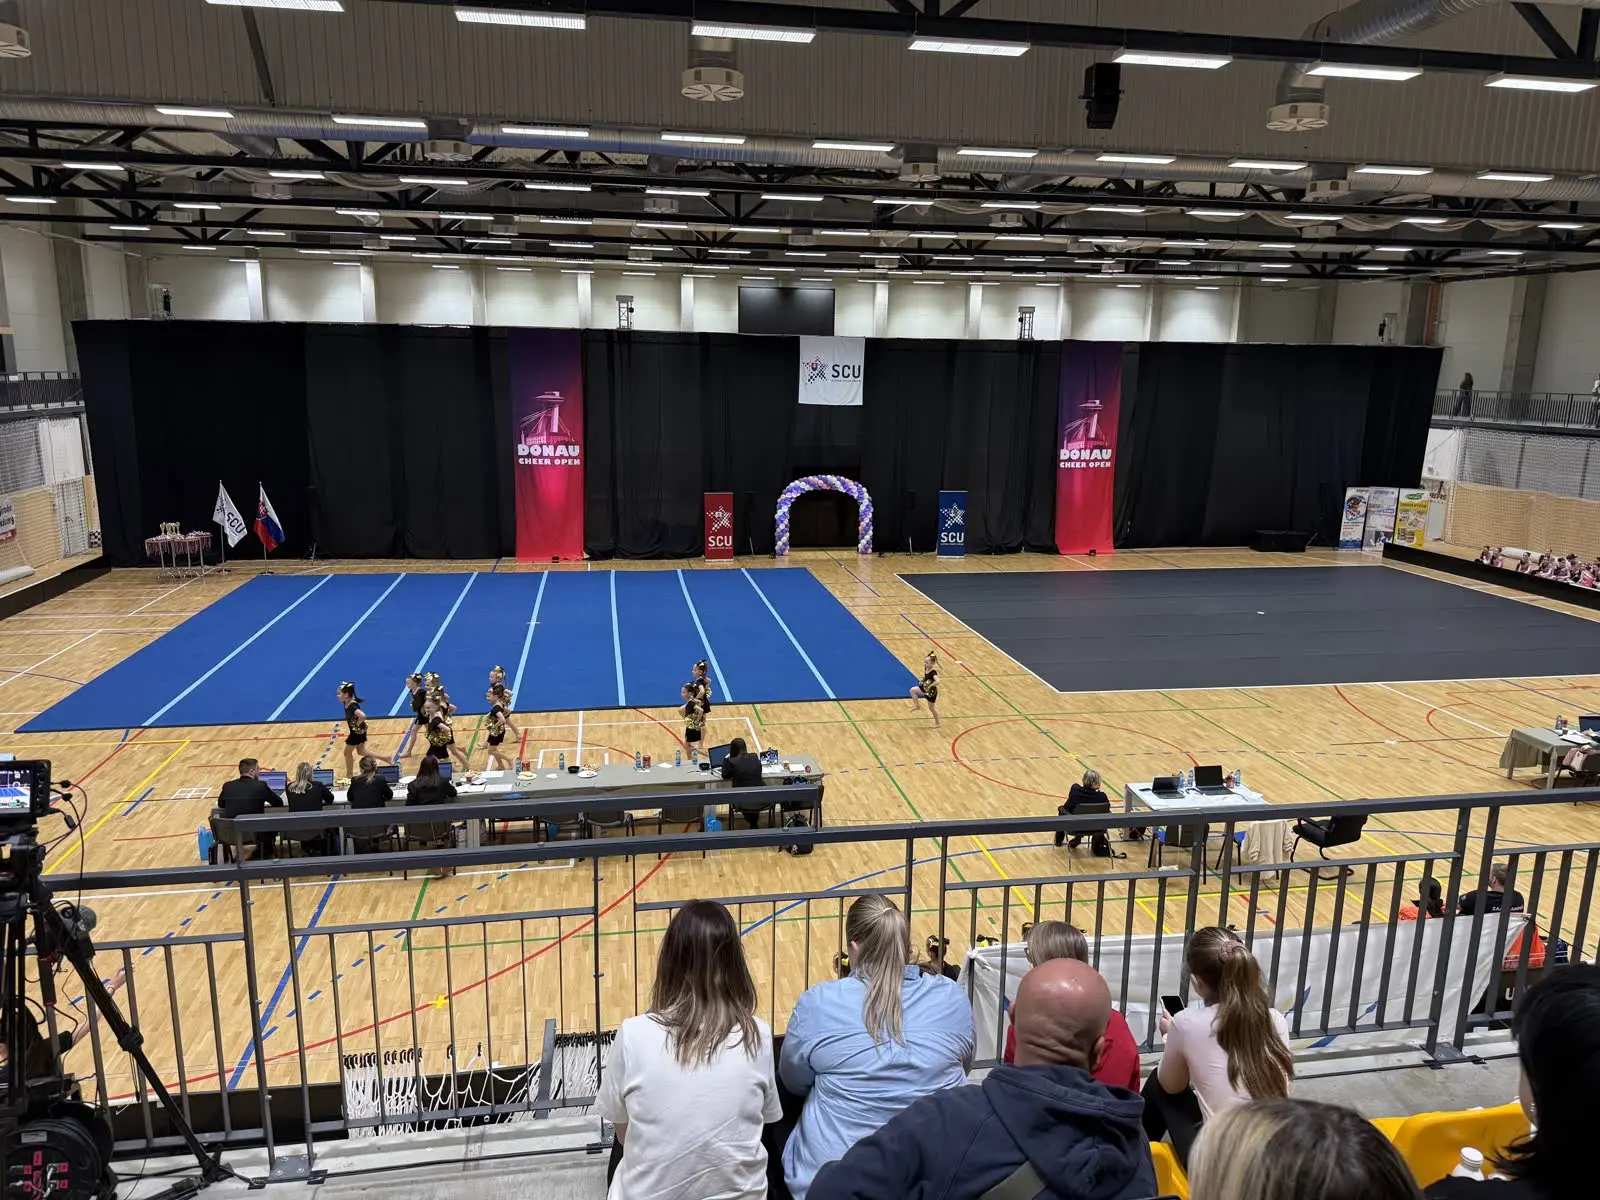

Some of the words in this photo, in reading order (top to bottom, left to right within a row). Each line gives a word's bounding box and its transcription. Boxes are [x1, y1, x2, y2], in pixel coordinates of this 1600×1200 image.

[831, 364, 861, 379] SCU
[517, 444, 580, 456] DONAU
[1060, 449, 1112, 460] DONAU
[518, 457, 551, 465] CHEER
[708, 535, 732, 546] SCU
[940, 532, 964, 543] SCU
